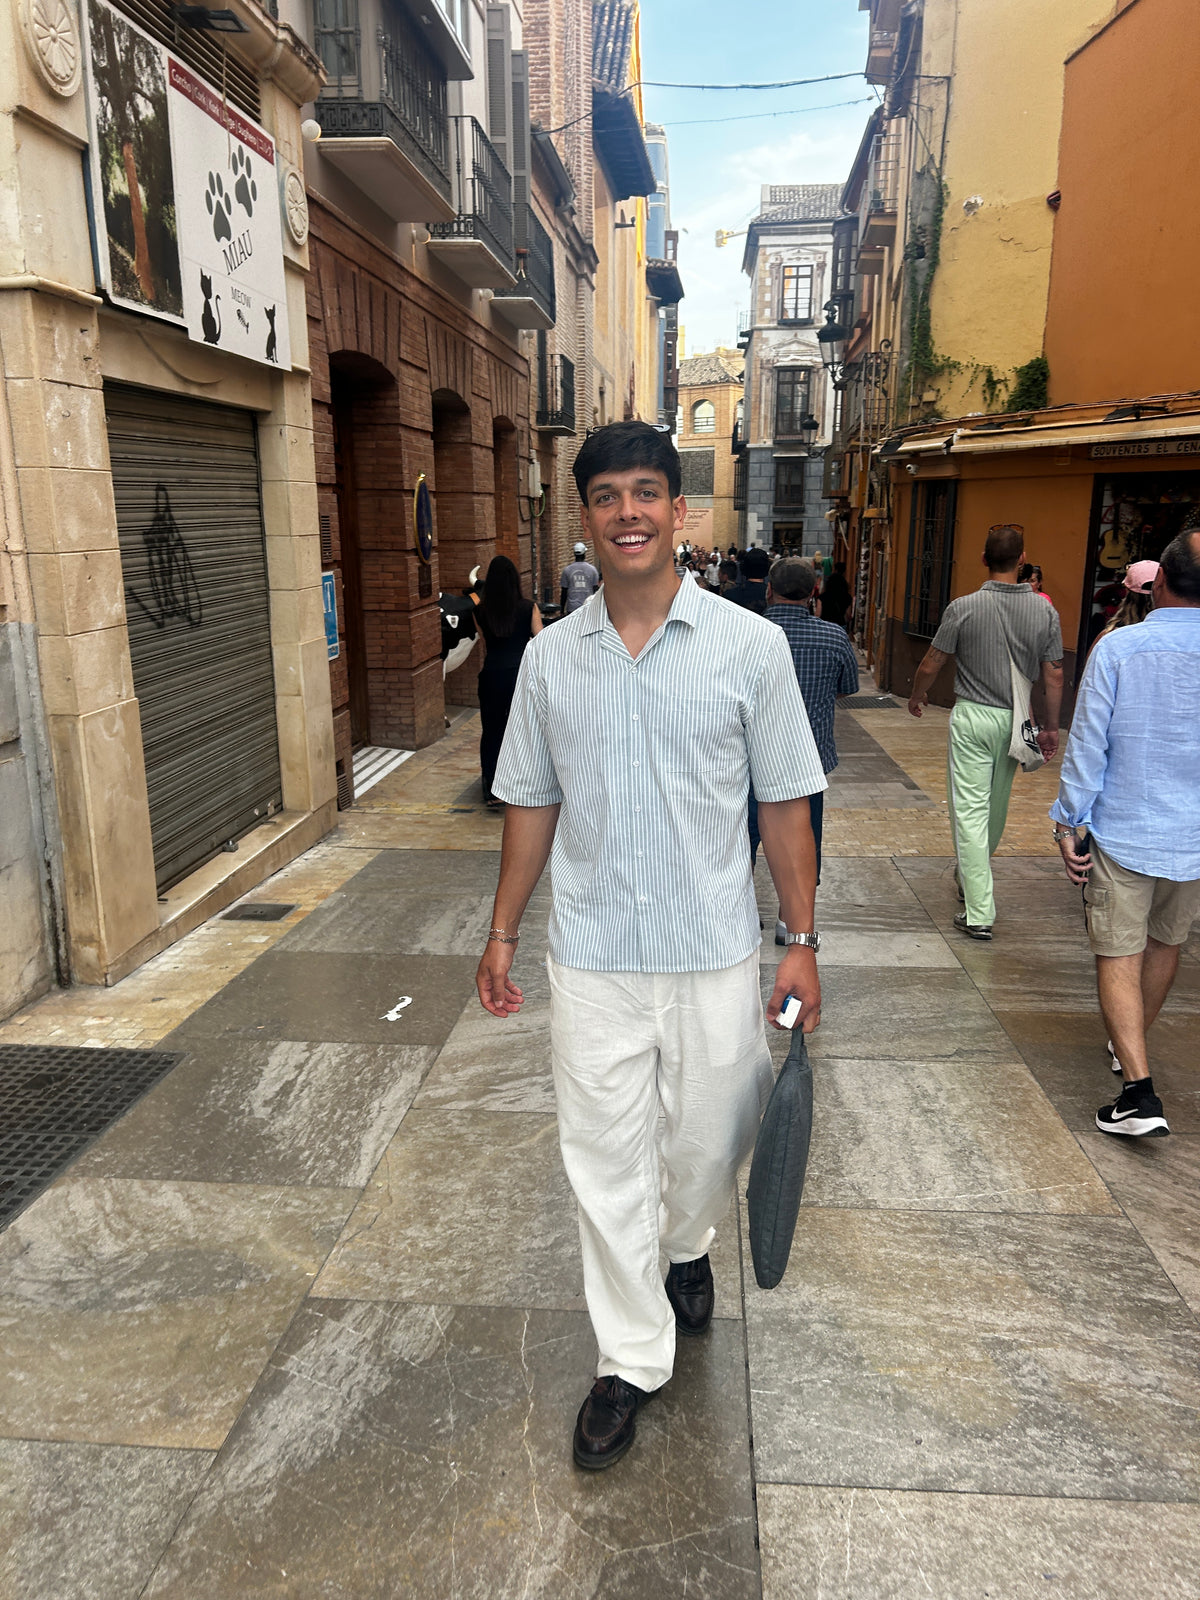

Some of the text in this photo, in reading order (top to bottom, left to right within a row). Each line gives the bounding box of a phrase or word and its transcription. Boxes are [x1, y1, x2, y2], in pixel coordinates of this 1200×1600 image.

[222, 229, 253, 275] MIAU
[231, 286, 252, 308] MEOW
[1094, 441, 1200, 456] SOUVENIRS EL CEN
